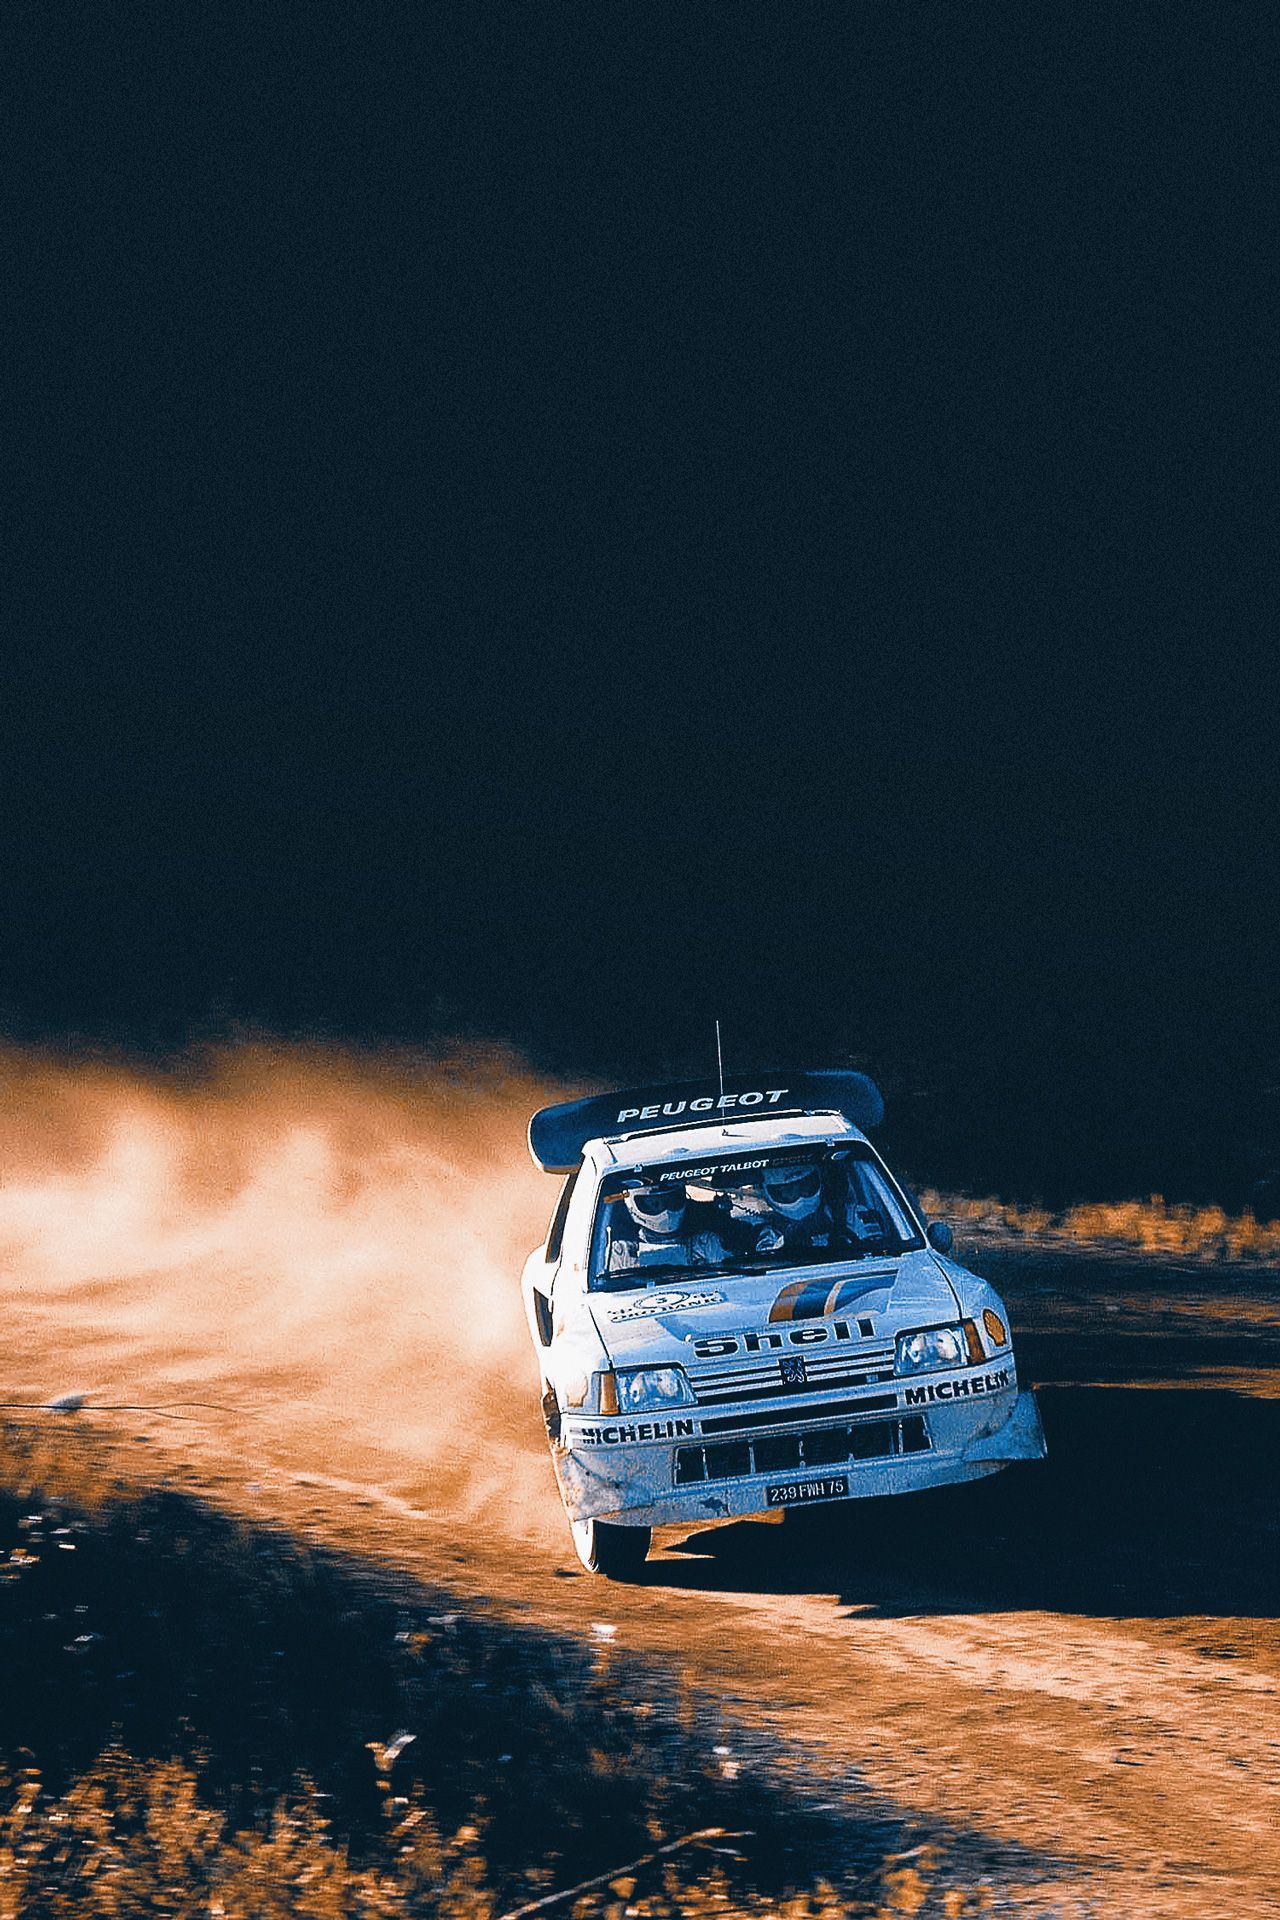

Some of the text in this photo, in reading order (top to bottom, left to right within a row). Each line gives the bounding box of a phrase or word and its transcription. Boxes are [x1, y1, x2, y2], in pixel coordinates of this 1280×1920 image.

[616, 1089, 789, 1123] PEUGEOT
[659, 1165, 719, 1182] PEUGEOT
[719, 1158, 770, 1173] TALBOT
[693, 1318, 875, 1358] Shell
[904, 1368, 1009, 1406] MICHELIN
[770, 1486, 797, 1502] 239
[827, 1479, 844, 1494] 75
